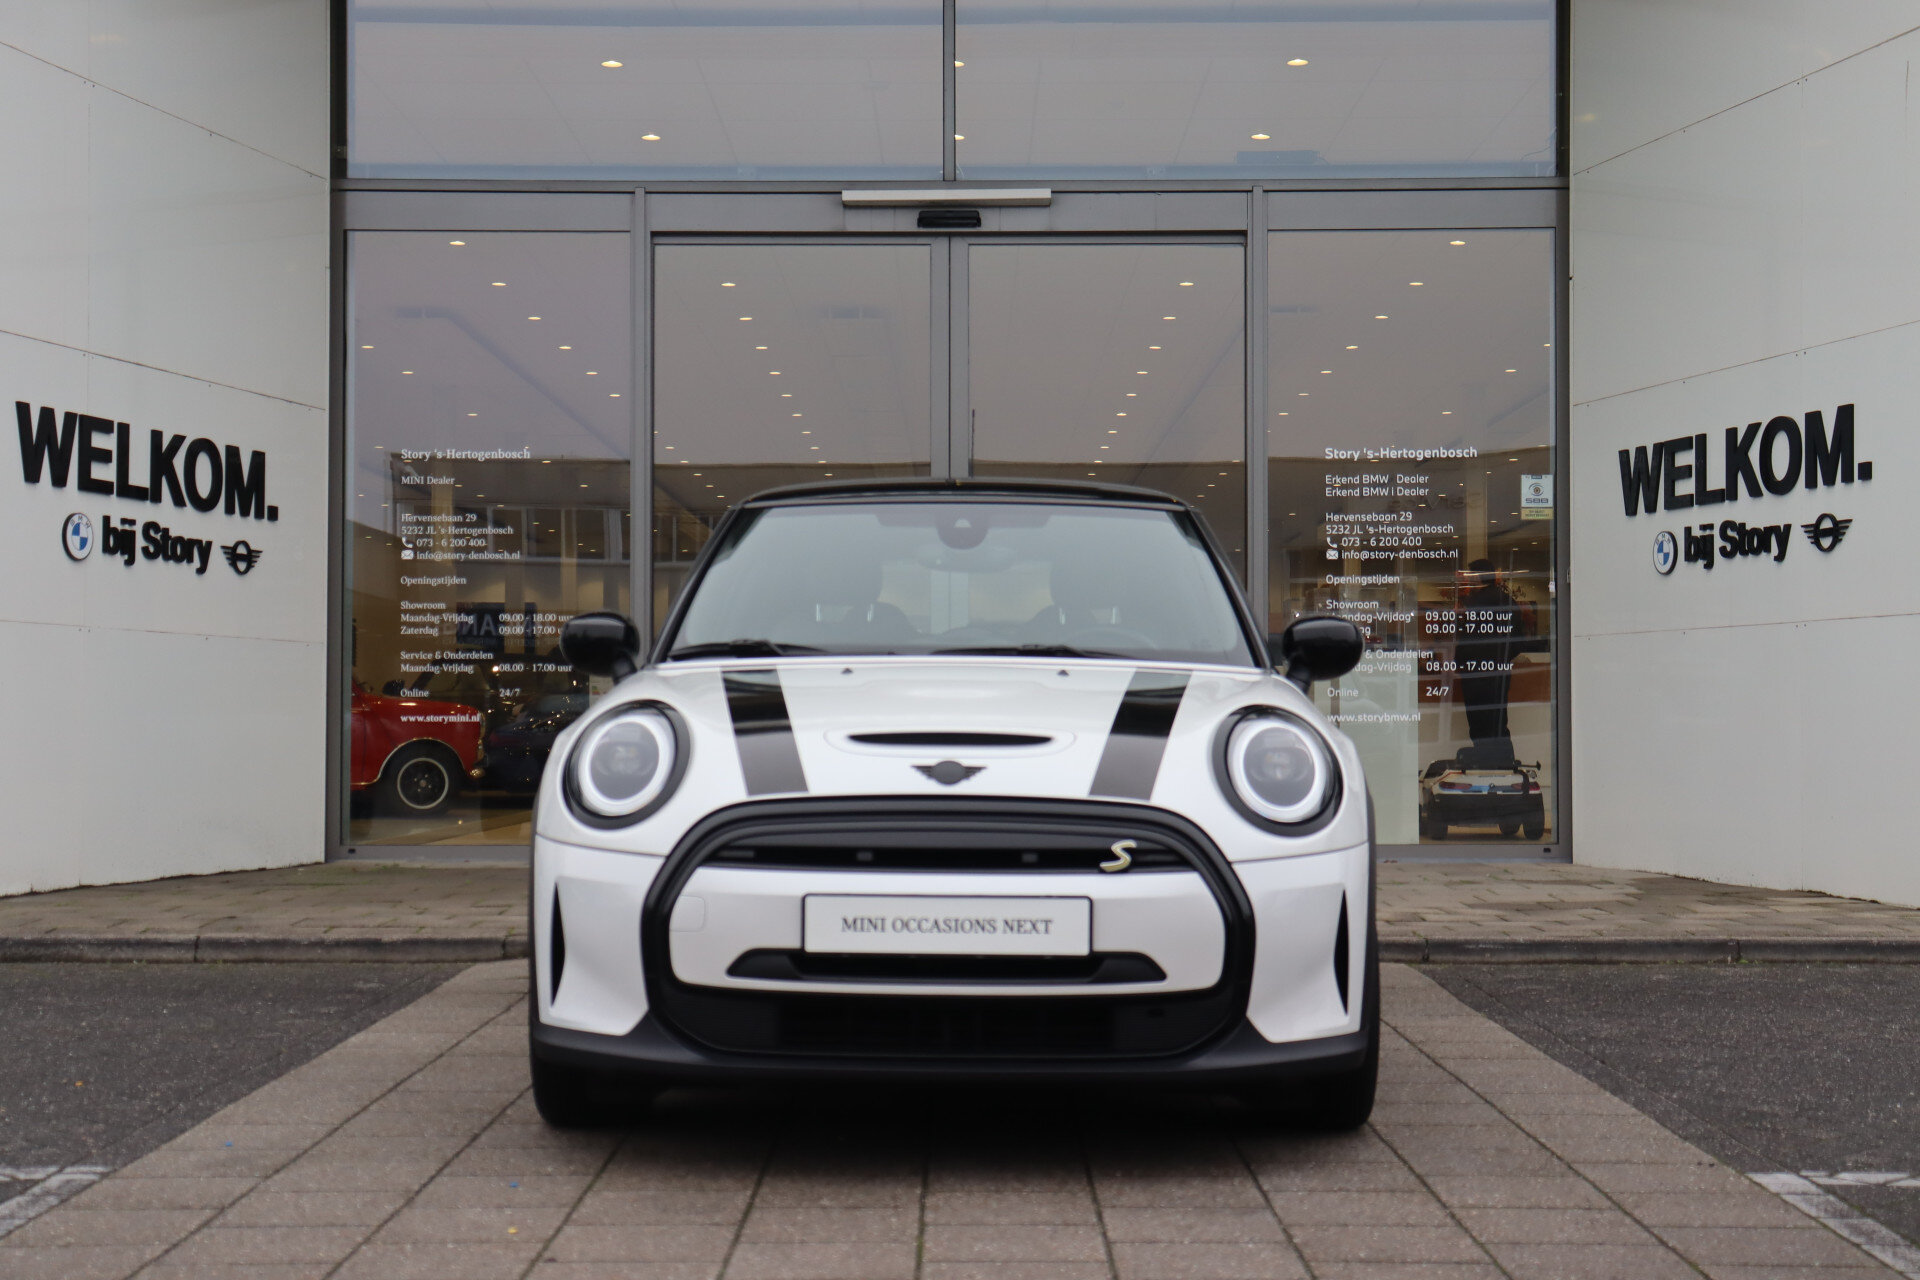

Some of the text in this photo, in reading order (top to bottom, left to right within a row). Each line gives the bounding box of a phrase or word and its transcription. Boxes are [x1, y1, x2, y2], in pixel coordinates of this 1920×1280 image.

[401, 449, 431, 461] Story
[1325, 447, 1478, 461] Story 's-Hertogenbosch
[15, 401, 279, 521] WELKOM.
[1618, 403, 1873, 517] WELKOM.
[401, 476, 456, 485] MINI Dealer
[1325, 474, 1429, 484] Erkend BMW Dealer
[1325, 487, 1360, 497] Erkend
[1362, 487, 1389, 497] BMW
[1396, 487, 1429, 497] Dealer
[401, 513, 477, 522] Hervensebaan 29
[1325, 512, 1412, 522] Hervensebaan 29
[401, 526, 423, 535] 5232
[425, 526, 437, 535] JL
[1326, 524, 1454, 536] 5232 JL 's-Hertogenbosch
[416, 539, 433, 547] 073
[441, 539, 447, 547] 6
[450, 539, 466, 547] 200
[468, 539, 485, 547] 400
[1341, 537, 1361, 547] 073
[1370, 537, 1376, 546] 6
[1379, 537, 1399, 547] 200
[1401, 537, 1422, 546] 400
[1719, 520, 1792, 562] Story
[141, 521, 213, 575] Story
[416, 550, 521, 561] info@story-denbosch.nl
[1342, 549, 1458, 561] info@story-denbosch.nl
[401, 576, 467, 586] Openingstijden
[1325, 574, 1400, 587] Openingstijden
[401, 601, 446, 610] Showroom
[1326, 600, 1379, 610] Showroom
[401, 614, 474, 624] Maandag-Vrijdag
[499, 613, 524, 622] 09.00
[532, 613, 556, 622] 18.00
[1425, 611, 1456, 621] 09.00
[1465, 611, 1493, 621] 18.00
[1496, 612, 1512, 621] uur
[401, 626, 439, 636] Zaterdag
[499, 626, 524, 635] 09.00
[532, 626, 555, 635] 17.00
[1425, 624, 1456, 634] 09.00
[1465, 624, 1494, 633] 17.00
[1496, 625, 1513, 633] uur
[401, 651, 493, 660] Service & Onderdelen
[1365, 649, 1433, 659] & Onderdelen
[401, 664, 474, 674] Maandag-Vrijdag
[499, 663, 524, 672] 08.00
[532, 663, 555, 672] 17.00
[1426, 661, 1456, 671] 08.00
[1466, 661, 1494, 671] 17.00
[1497, 662, 1514, 671] uur
[401, 688, 521, 697] Online 24/7
[1327, 686, 1449, 697] Online 24/7
[400, 713, 481, 723] www.storymini.nl
[1327, 712, 1421, 723] www.storybmw.nl
[841, 917, 1054, 935] MINI OCCASIONS NEXT
